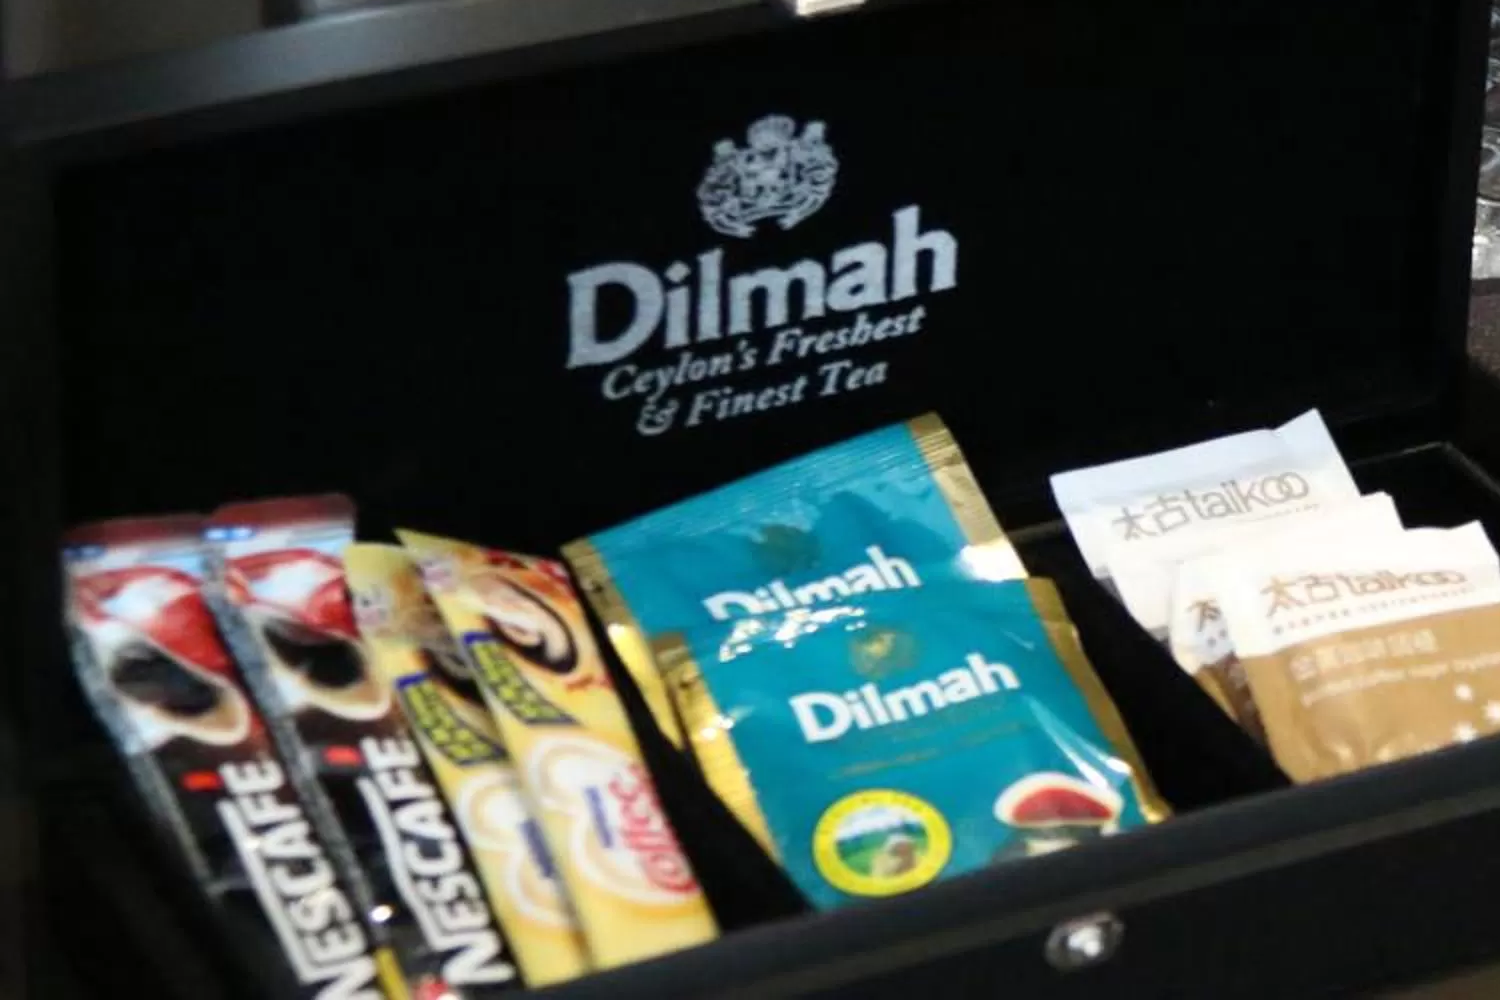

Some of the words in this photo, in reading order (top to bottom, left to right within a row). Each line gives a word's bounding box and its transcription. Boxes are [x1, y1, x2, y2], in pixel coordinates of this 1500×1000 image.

[565, 203, 958, 370] Dilmah
[602, 340, 757, 400] Ceylon's
[766, 305, 926, 367] Freshest
[635, 399, 679, 437] &
[685, 377, 809, 427] Finest
[818, 359, 889, 398] Tea
[788, 652, 1021, 743] Dilmah
